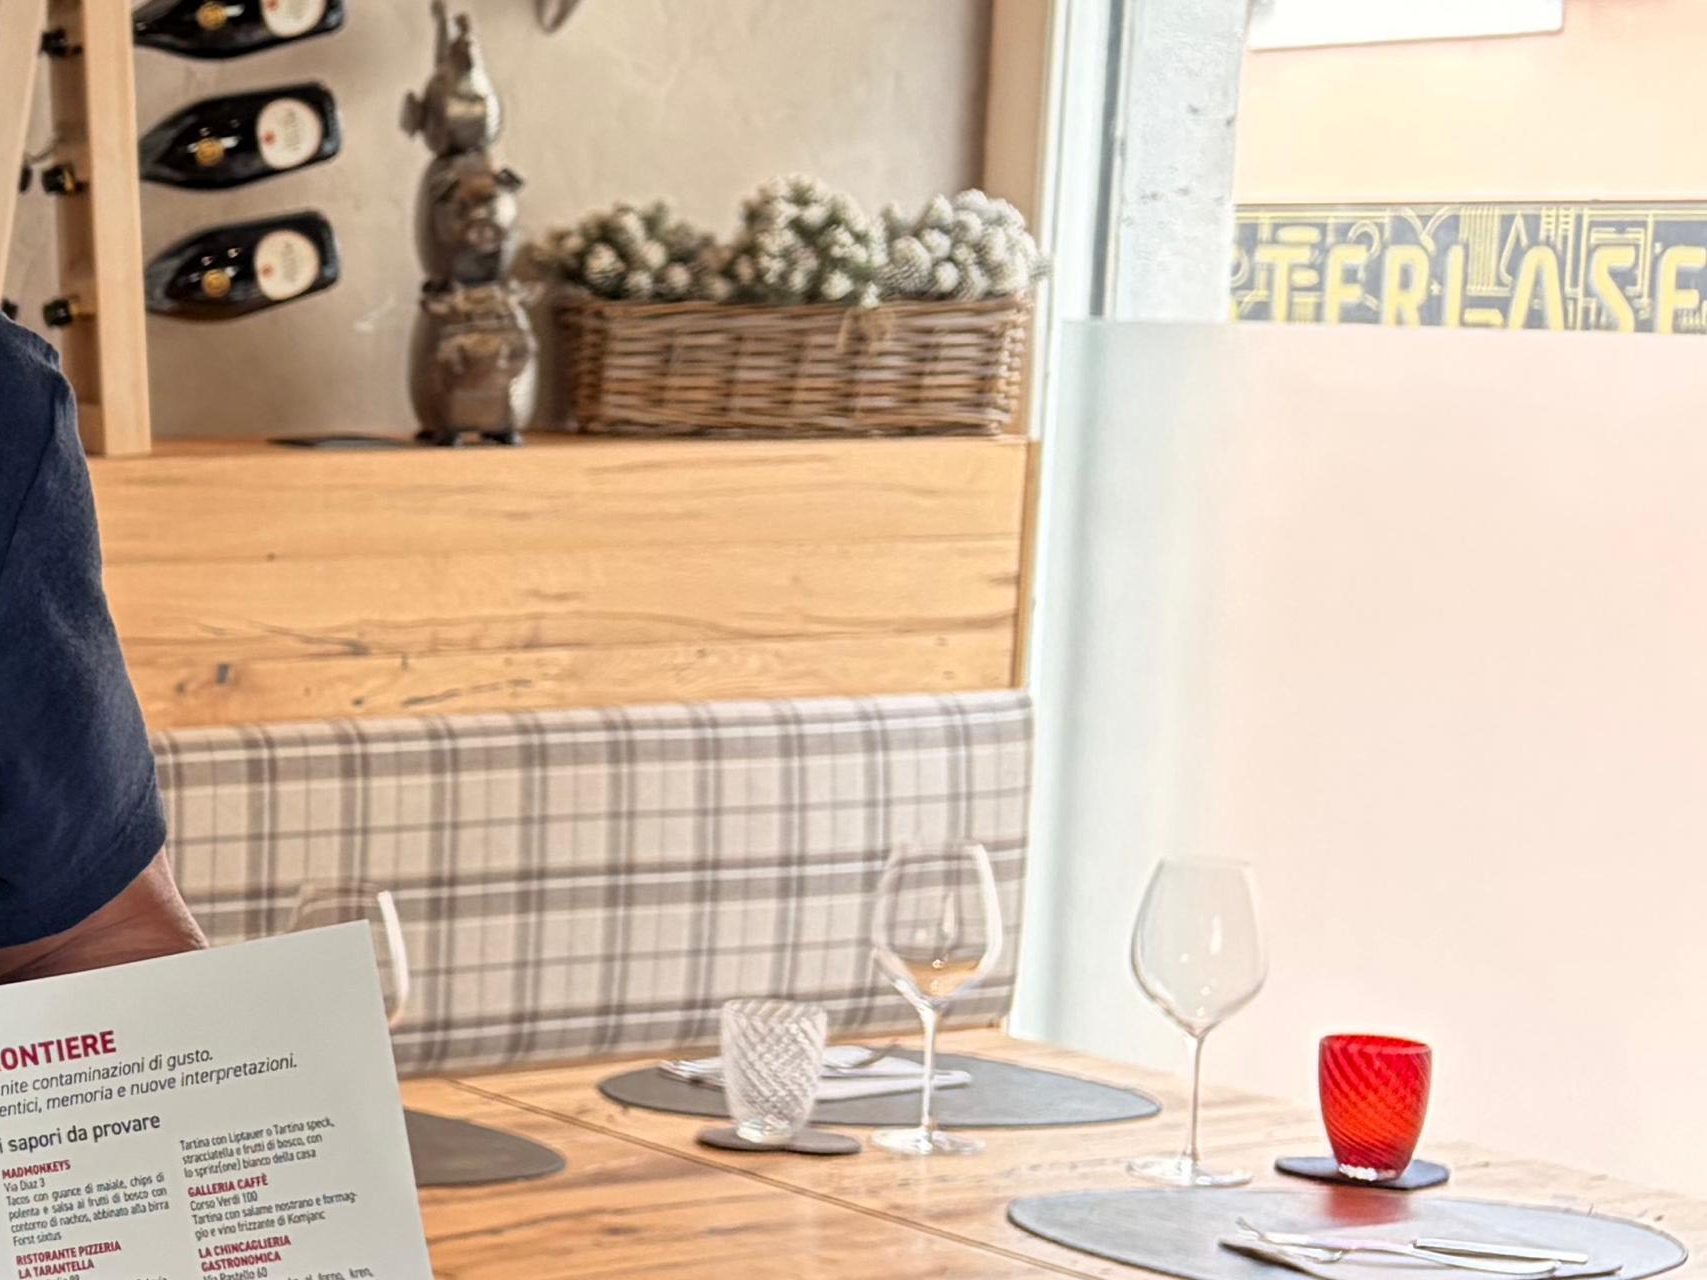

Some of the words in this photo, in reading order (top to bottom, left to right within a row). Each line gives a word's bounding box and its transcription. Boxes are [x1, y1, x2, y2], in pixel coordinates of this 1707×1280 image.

[32, 1059, 144, 1090] contaminazioni
[148, 1055, 162, 1071] di
[166, 1051, 213, 1071] gusto.
[46, 1087, 113, 1109] memoria
[117, 1087, 126, 1098] e
[130, 1078, 176, 1095] nuove
[181, 1055, 297, 1086] interpretazioni.
[7, 1129, 62, 1152] sapori
[66, 1126, 88, 1143] da
[92, 1117, 160, 1142] provare
[2, 1161, 71, 1179] MADMONKEYS
[188, 1182, 236, 1197] GALLERIA
[238, 1174, 268, 1189] CAFFÈ
[17, 1248, 77, 1265] RISTORANTE
[79, 1242, 121, 1256] PIZZERIA
[199, 1248, 213, 1259] LA
[214, 1236, 291, 1256] CHINCAGLIERIA
[19, 1269, 32, 1279] LA
[34, 1260, 94, 1276] TARANTELLA
[202, 1252, 281, 1272] GASTRONOMICA
